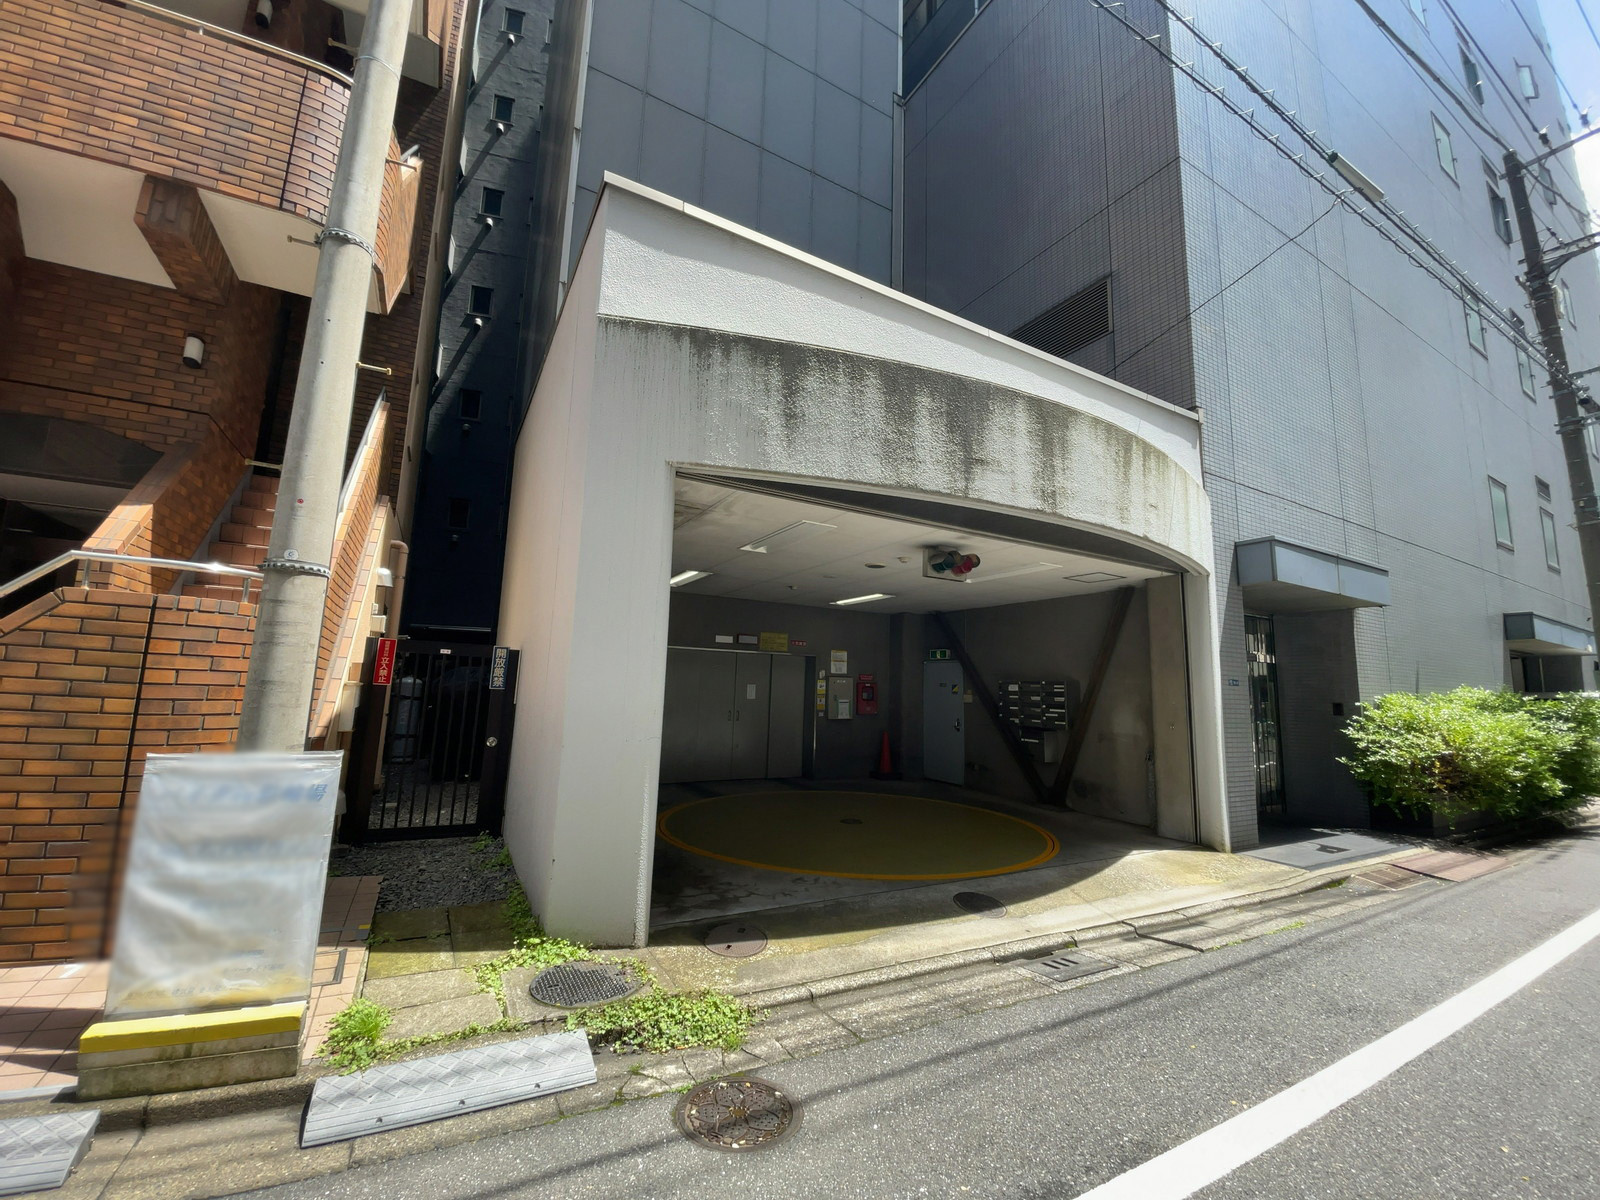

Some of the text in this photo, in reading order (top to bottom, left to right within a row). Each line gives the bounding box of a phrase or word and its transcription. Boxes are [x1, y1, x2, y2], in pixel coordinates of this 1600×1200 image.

[378, 657, 390, 683] 立入禁止
[492, 648, 507, 687] 開放厳禁
